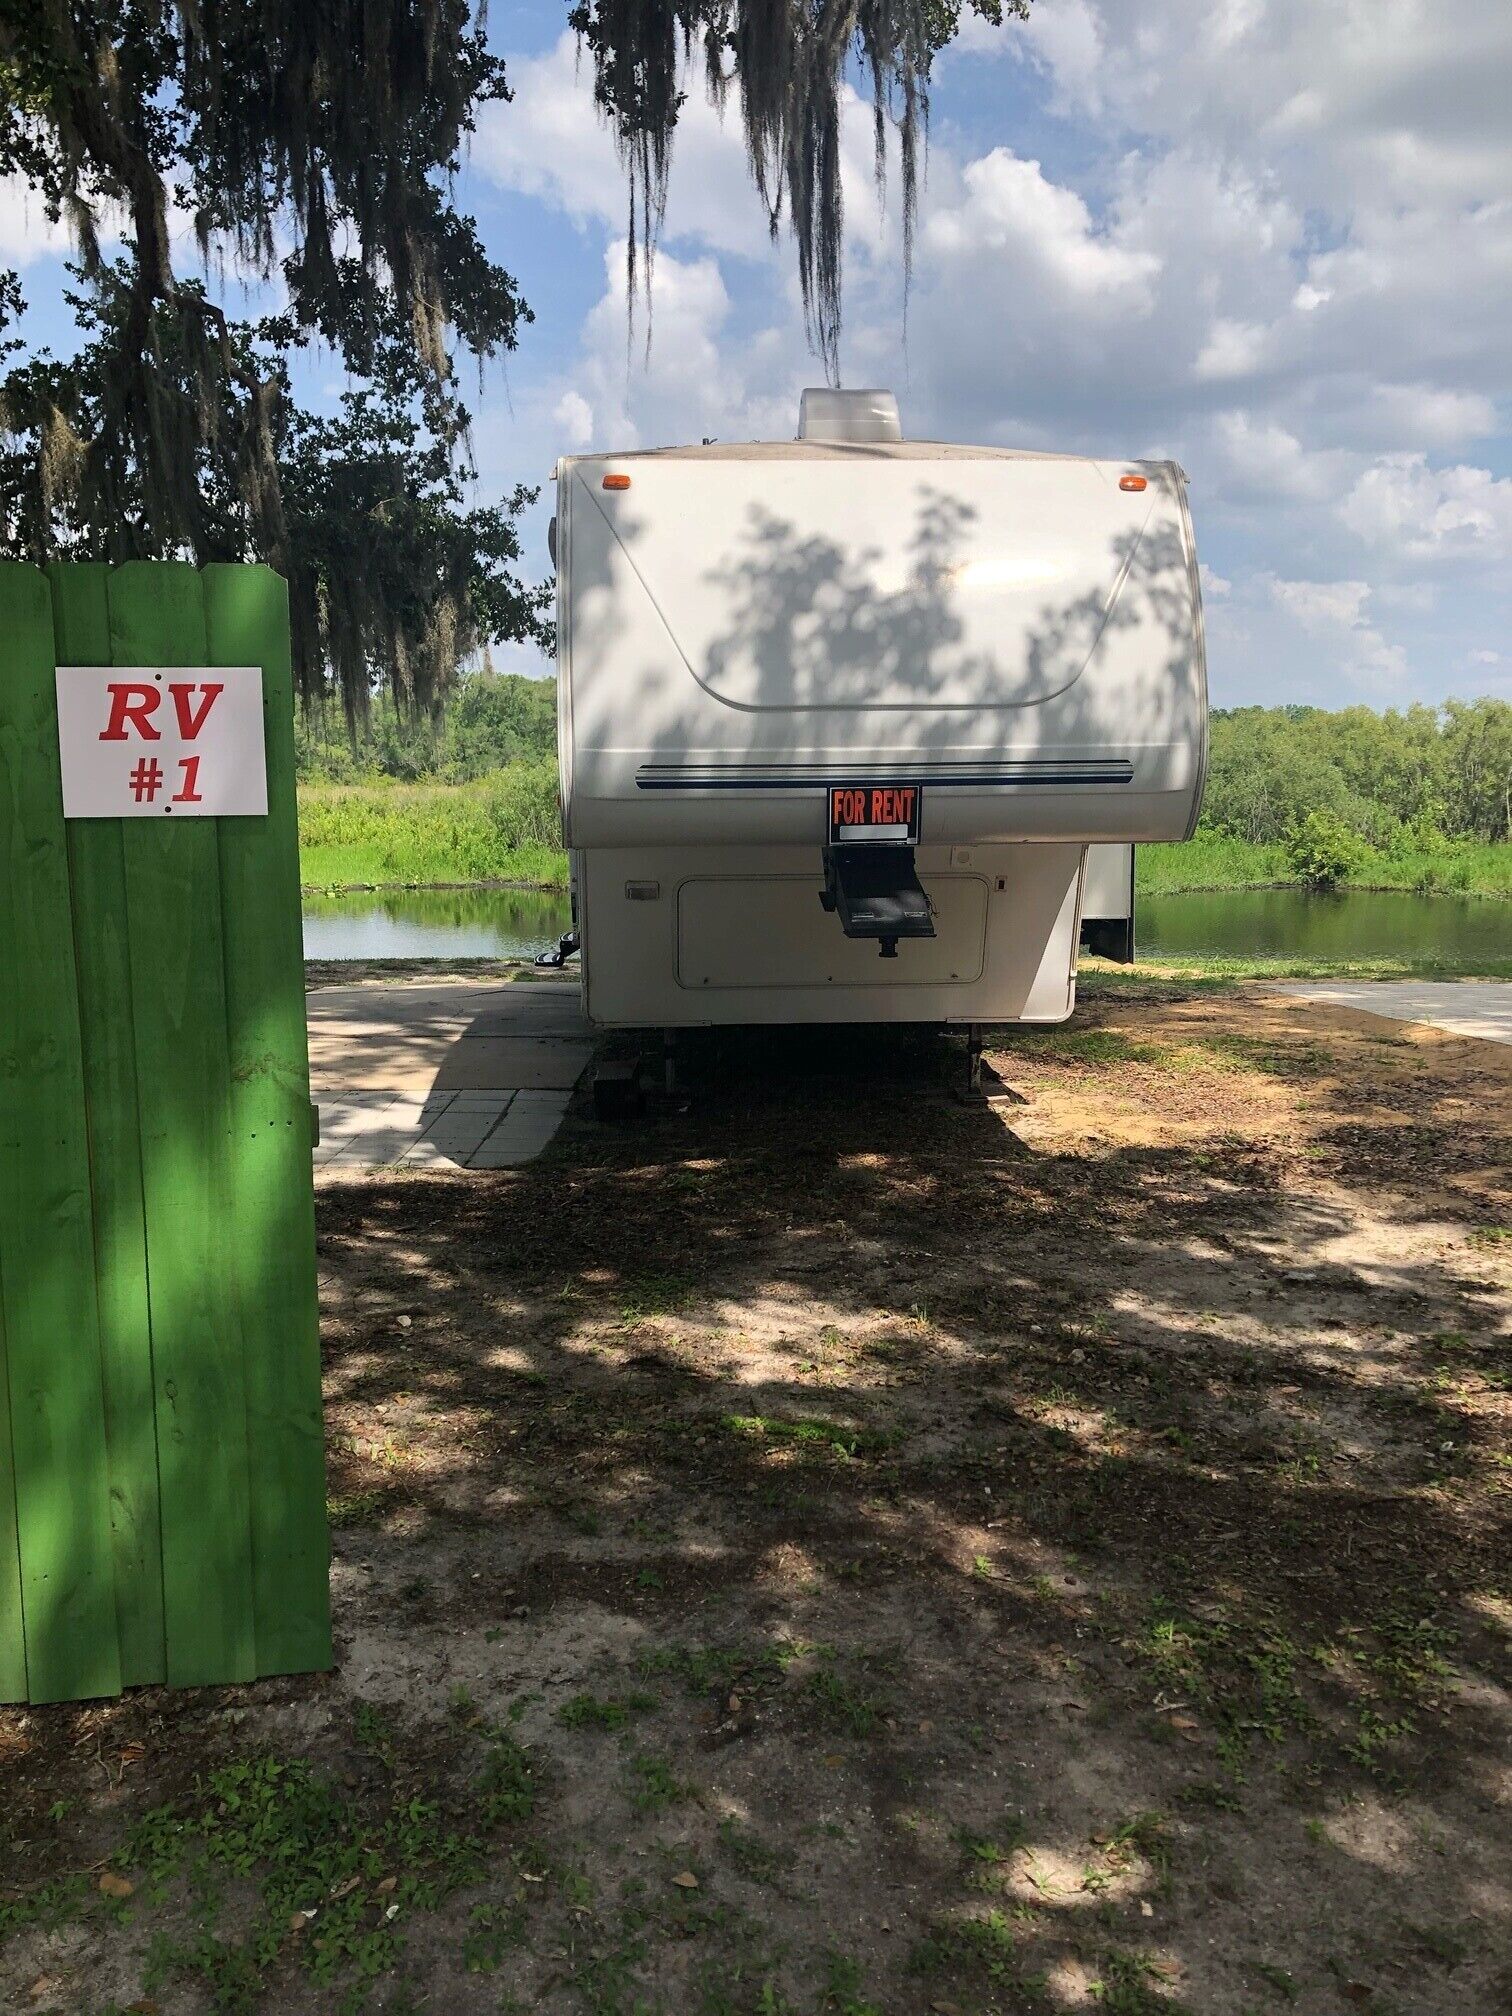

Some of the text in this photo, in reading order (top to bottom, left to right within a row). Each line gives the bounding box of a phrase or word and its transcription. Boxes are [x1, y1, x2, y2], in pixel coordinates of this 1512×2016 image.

[98, 683, 225, 741] RV
[128, 755, 203, 802] #1
[834, 789, 915, 825] FOR RENT
